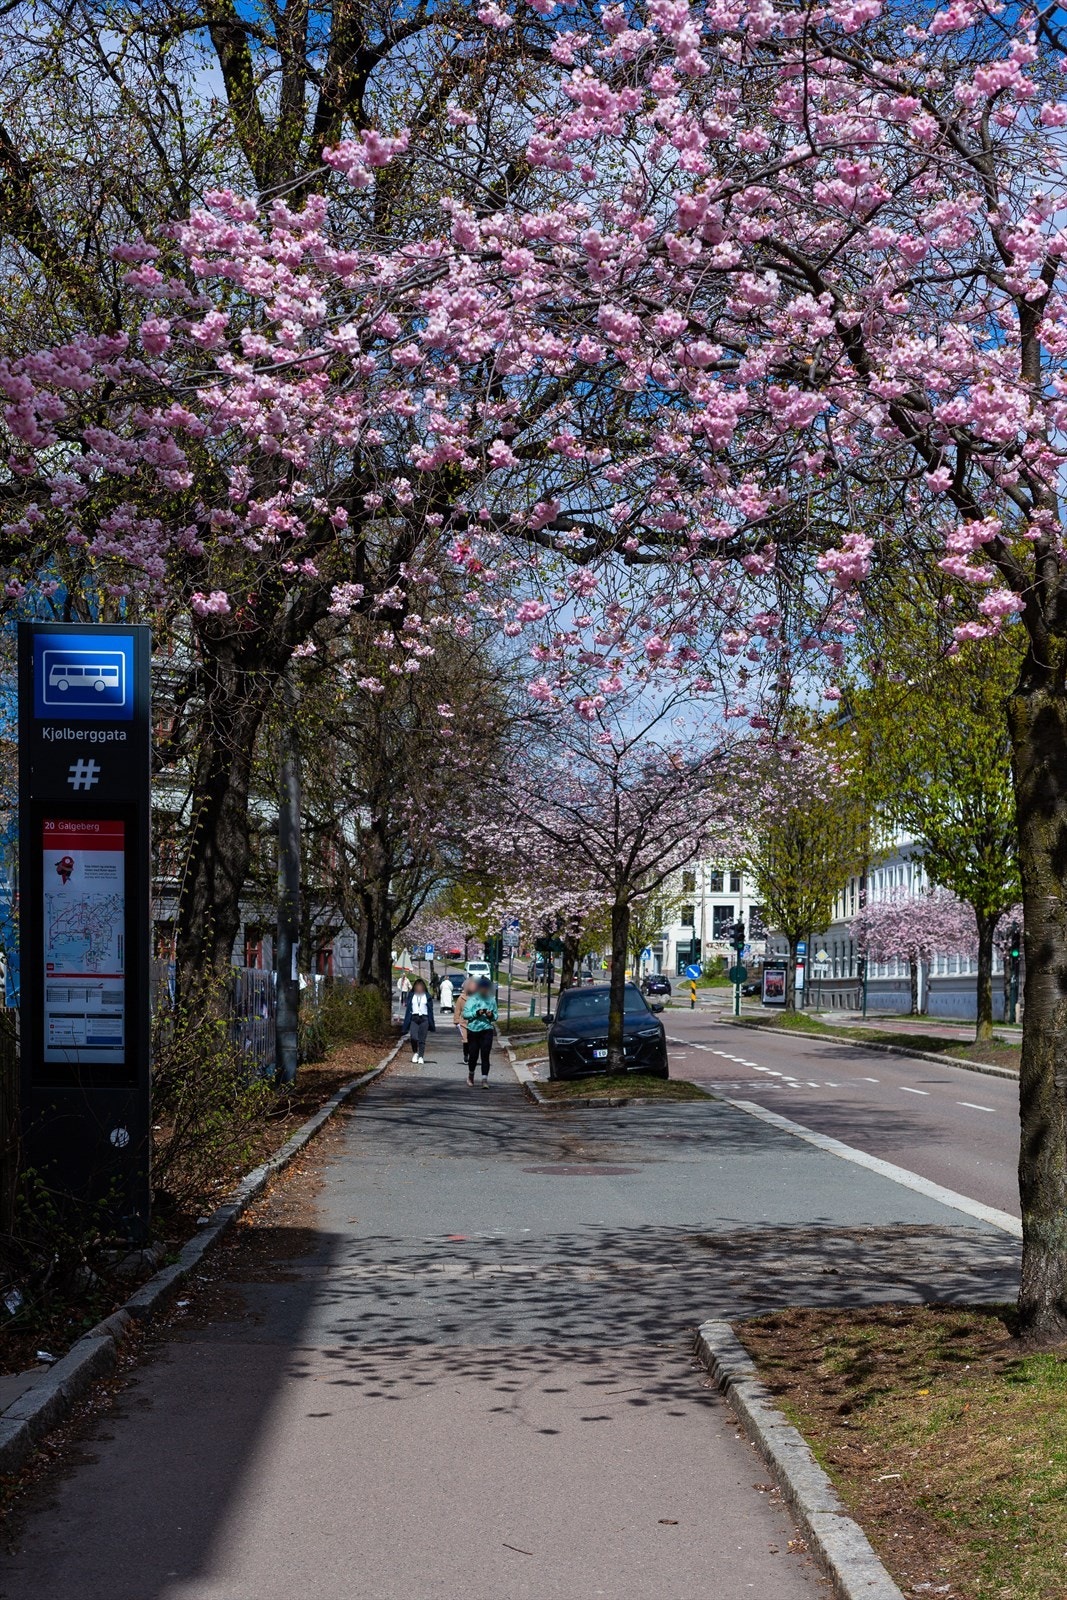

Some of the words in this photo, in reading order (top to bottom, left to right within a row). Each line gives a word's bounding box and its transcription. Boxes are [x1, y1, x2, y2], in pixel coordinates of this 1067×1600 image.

[42, 727, 127, 743] Kjølberggata
[44, 821, 55, 830] 20
[57, 821, 100, 832] Galgeberg
